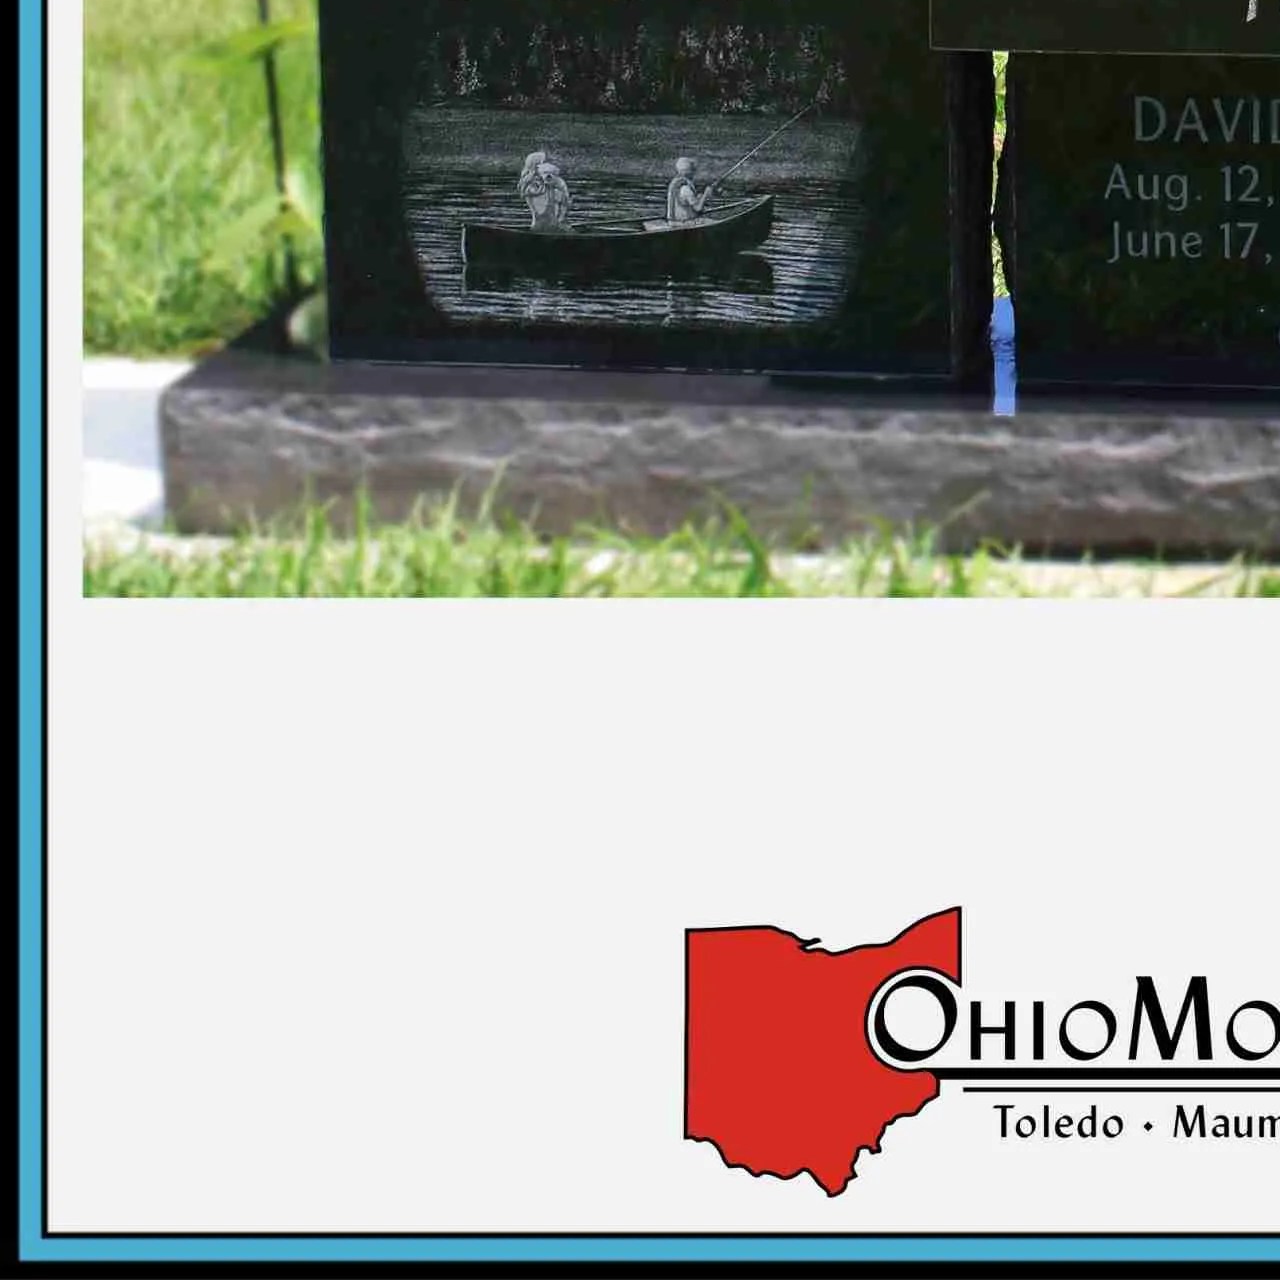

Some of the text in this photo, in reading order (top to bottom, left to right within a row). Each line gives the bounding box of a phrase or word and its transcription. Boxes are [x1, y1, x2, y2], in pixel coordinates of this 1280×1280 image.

[1104, 163, 1202, 212] Aug.
[1220, 165, 1275, 207] 12,
[1106, 221, 1203, 264] June
[1219, 222, 1273, 264] 17,
